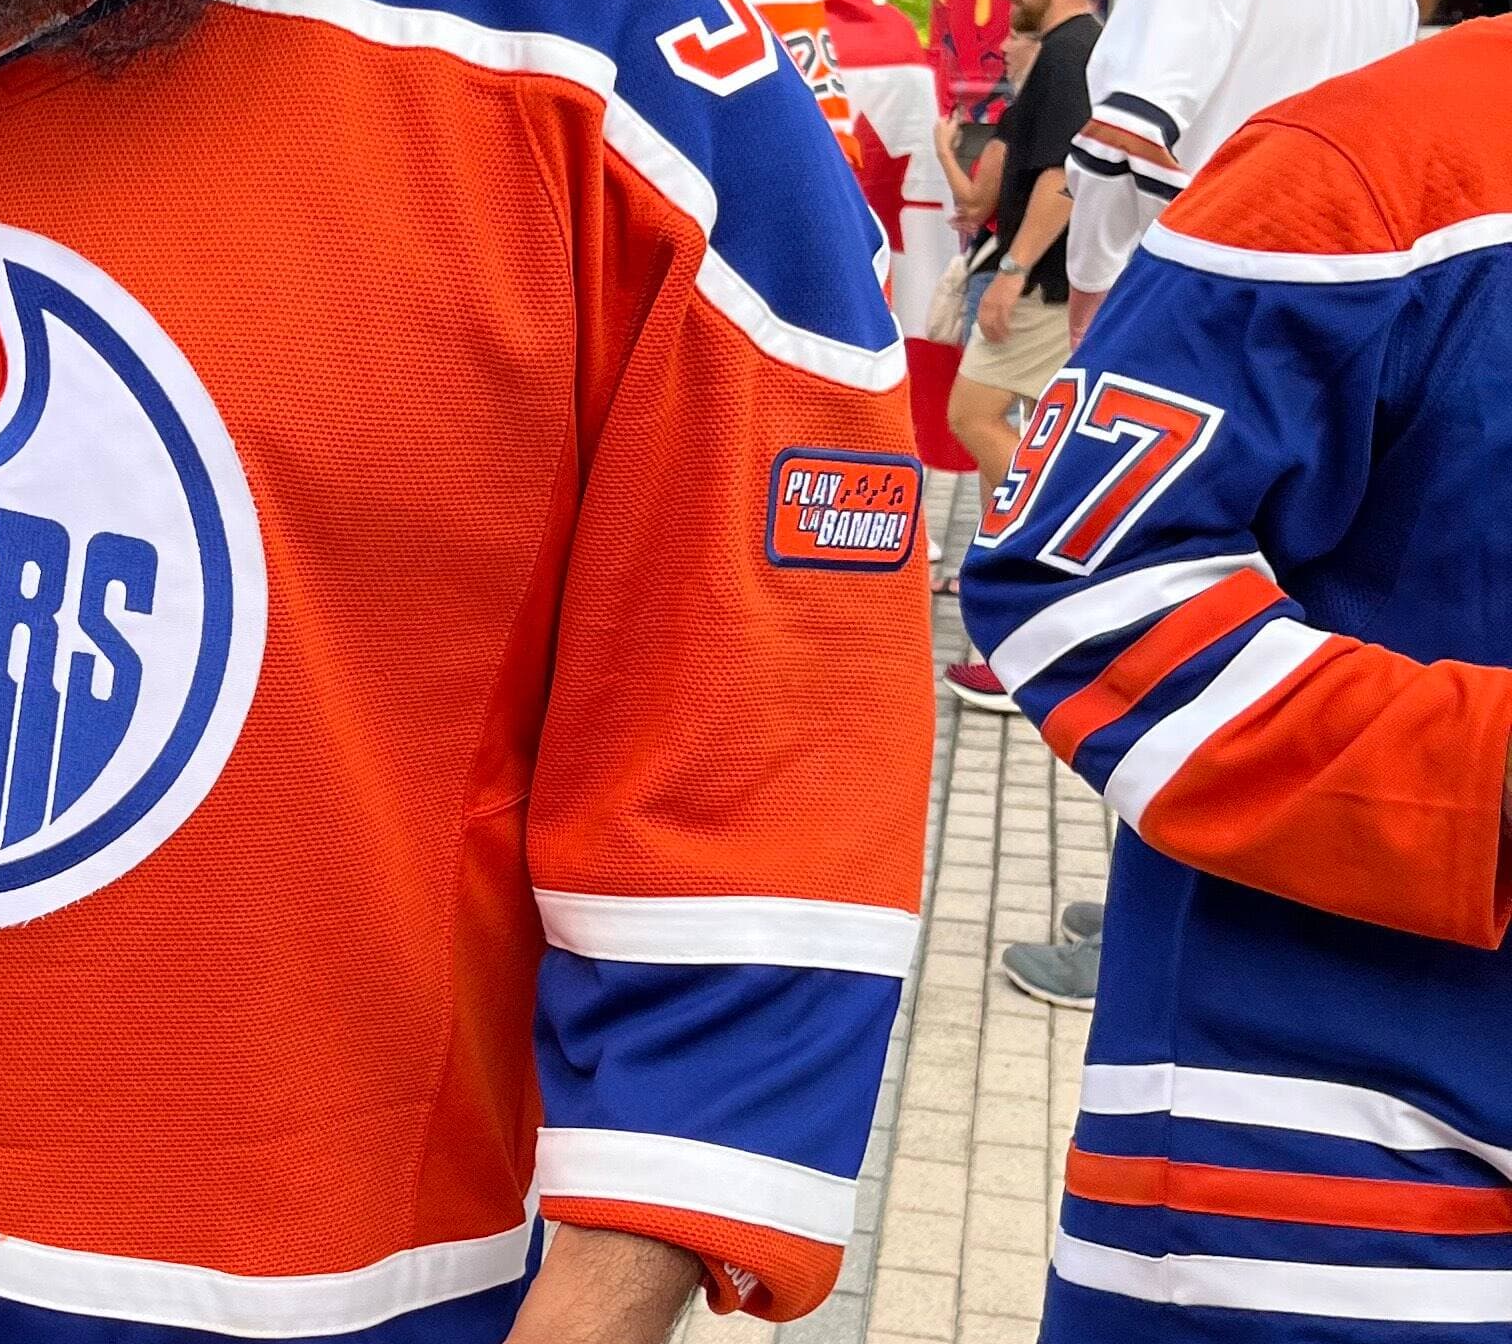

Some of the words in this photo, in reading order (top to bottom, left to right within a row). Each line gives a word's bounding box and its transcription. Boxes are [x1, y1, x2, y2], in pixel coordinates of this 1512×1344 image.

[784, 471, 843, 505] PLAY
[974, 367, 1225, 576] 97
[798, 509, 820, 531] LA
[816, 509, 908, 549] BAMBA!
